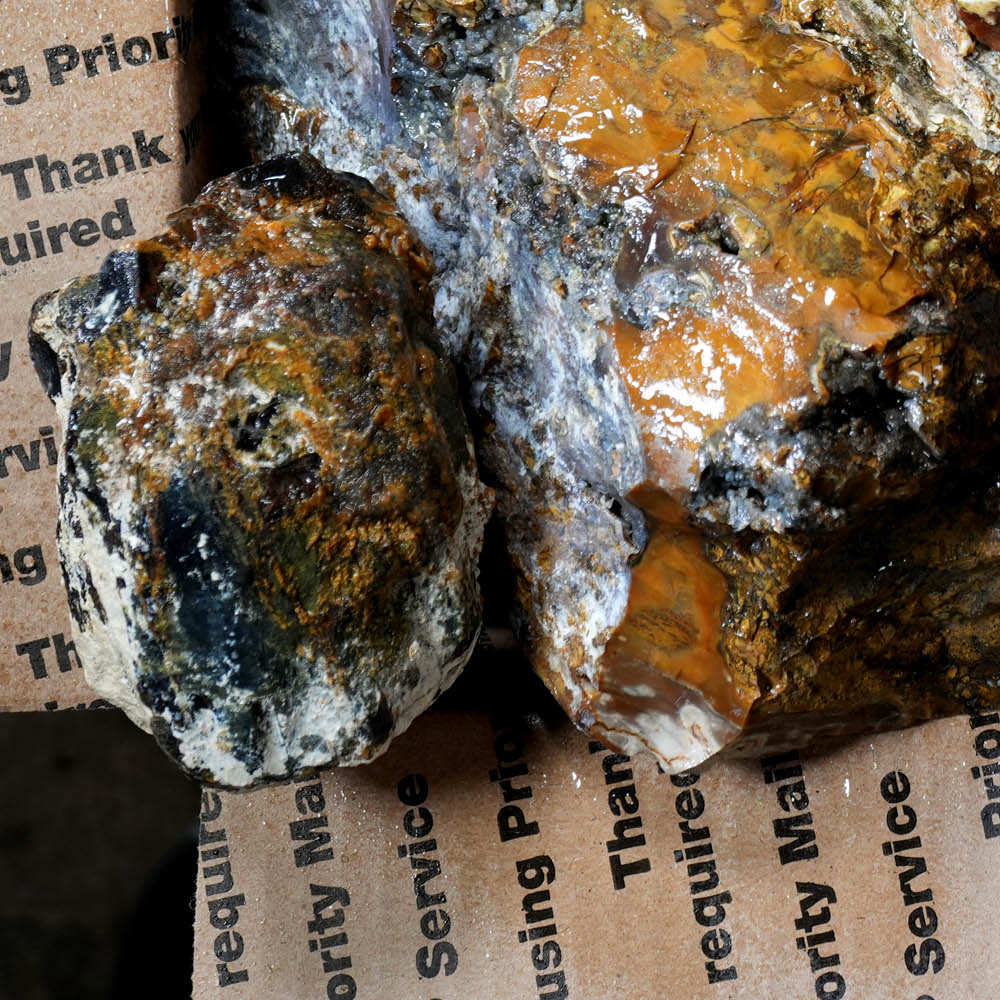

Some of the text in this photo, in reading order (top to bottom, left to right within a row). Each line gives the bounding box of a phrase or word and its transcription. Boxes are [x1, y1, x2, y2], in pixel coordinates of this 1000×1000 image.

[0, 129, 171, 200] Thank
[398, 773, 459, 979] Service
[590, 741, 651, 890] Than
[880, 770, 946, 977] Service
[515, 854, 570, 1000] using
